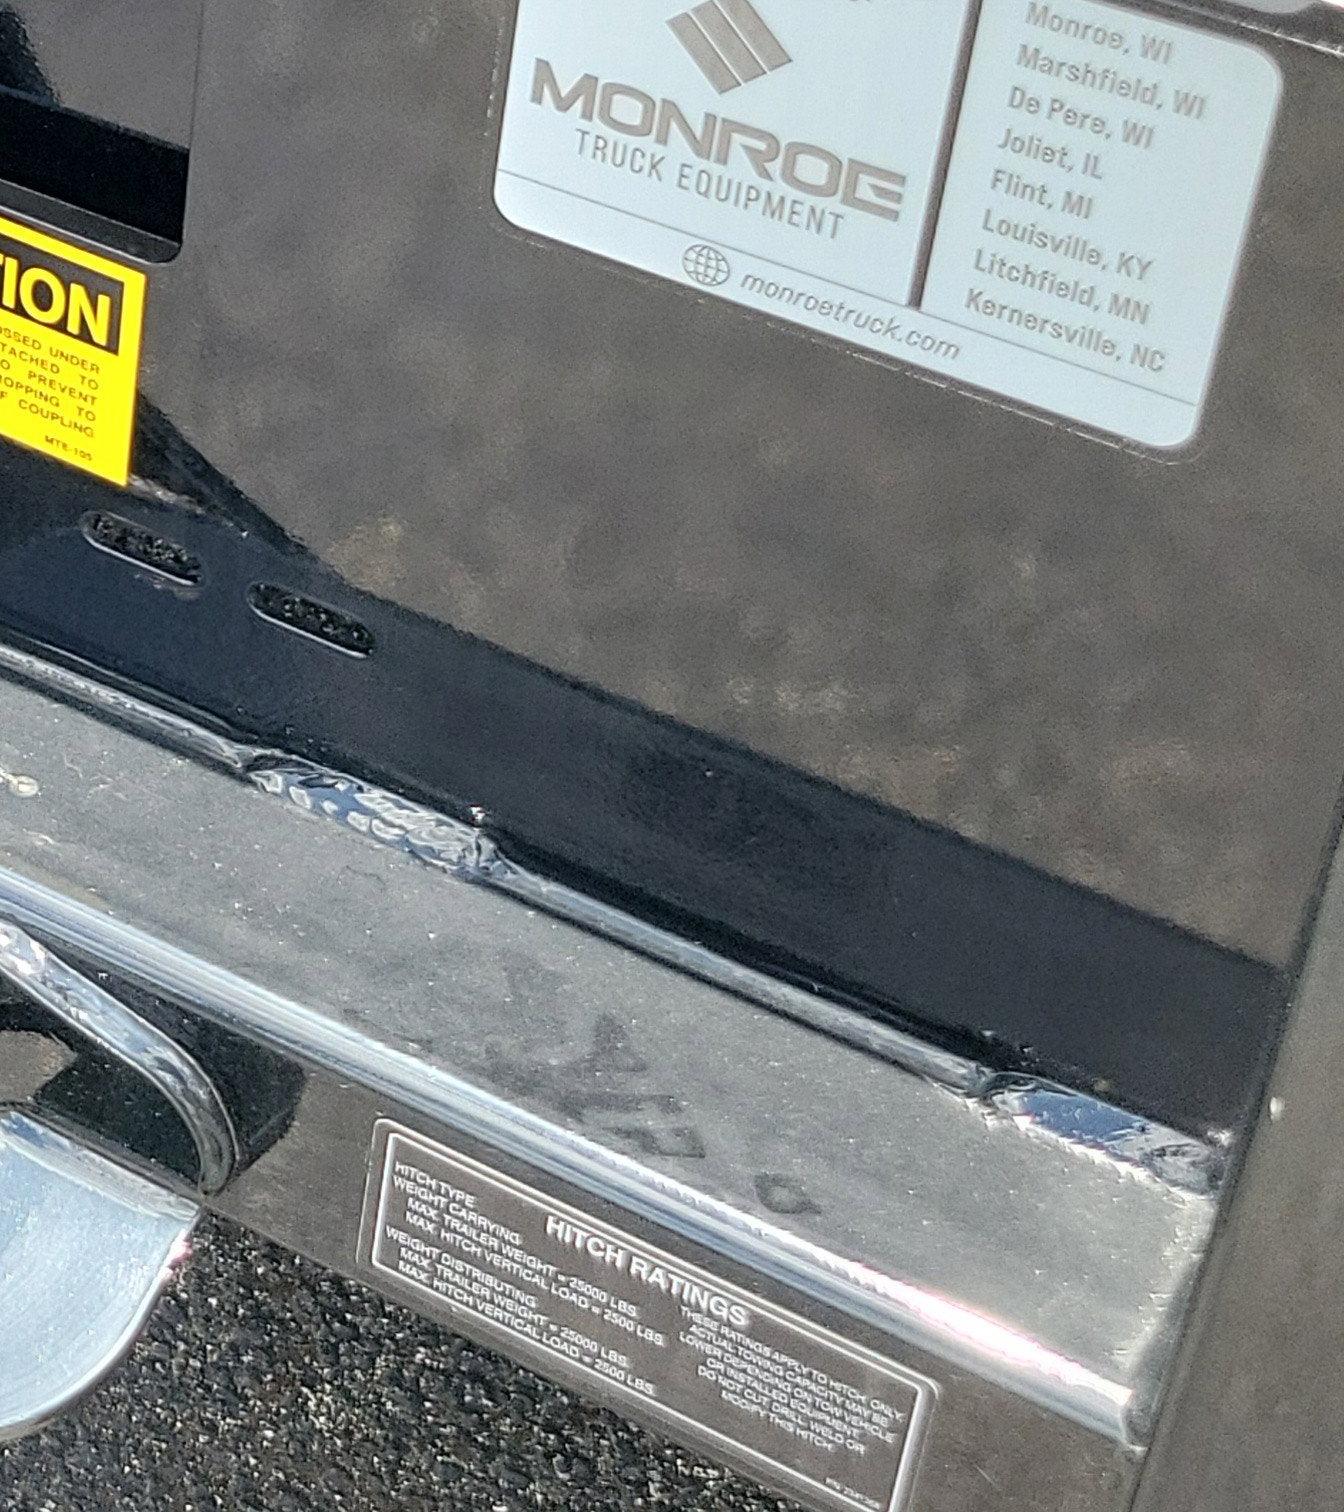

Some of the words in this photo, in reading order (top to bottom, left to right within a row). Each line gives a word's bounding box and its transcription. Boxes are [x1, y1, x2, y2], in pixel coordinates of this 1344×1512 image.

[1024, 1, 1133, 55] Monroe,
[1136, 34, 1172, 66] WI
[1006, 85, 1043, 118] De
[1046, 97, 1116, 141] Pere,
[1118, 119, 1155, 151] WI
[1014, 42, 1168, 111] Marshfield,
[1169, 88, 1207, 121] WI
[529, 57, 908, 222] MONROE
[997, 126, 1079, 174] Joliet,
[1080, 152, 1106, 181] IL
[573, 128, 666, 183] TRUCK
[675, 162, 845, 242] EQUIPMENT
[989, 168, 1058, 210] Flint,
[1060, 190, 1093, 220] MI
[981, 208, 1112, 271] Louisville,
[1113, 250, 1152, 282] KY
[739, 268, 961, 362] monroetruck.com
[972, 248, 1105, 312] Litchfield,
[1106, 292, 1149, 325] MN
[48, 345, 99, 375] UNDER
[963, 288, 1126, 362] Kernersville,
[1128, 342, 1166, 374] NC
[18, 397, 94, 438] COUPLING
[27, 369, 96, 407] PREVENT
[76, 406, 95, 422] TO
[79, 374, 98, 391] TO
[393, 1174, 447, 1211] WEIGHT
[394, 1159, 436, 1191] HITCH
[385, 1223, 439, 1261] WEIGHT
[440, 1250, 537, 1310] DISTRIBUTING
[440, 1226, 482, 1258] HITCH
[482, 1247, 552, 1292] VERTICAL
[550, 1281, 590, 1311] LOAD
[602, 1307, 635, 1333] 2500
[442, 1213, 499, 1251] TRAILER
[501, 1242, 555, 1279] WEIGHT
[568, 1275, 607, 1304] 25000
[543, 1214, 625, 1270] HITCH
[627, 1254, 750, 1330] RATINGS
[432, 1277, 474, 1308] HITCH
[474, 1297, 542, 1342] VERTICAL
[541, 1331, 580, 1360] LOAD
[593, 1357, 625, 1382] 2500
[435, 1263, 490, 1301] TRAILER
[492, 1292, 546, 1329] WEIGHT
[559, 1325, 598, 1354] 25000
[679, 1304, 721, 1333] THESE
[719, 1324, 772, 1358] RATINGS
[771, 1349, 809, 1376] APPLY
[810, 1368, 828, 1385] TO
[688, 1321, 736, 1353] ACTUAL
[735, 1344, 785, 1377] TOWING
[784, 1368, 844, 1406] CAPACITY
[843, 1397, 869, 1419] MAY
[696, 1363, 717, 1383] DO
[717, 1374, 744, 1395] NOT
[843, 1437, 866, 1456] OR
